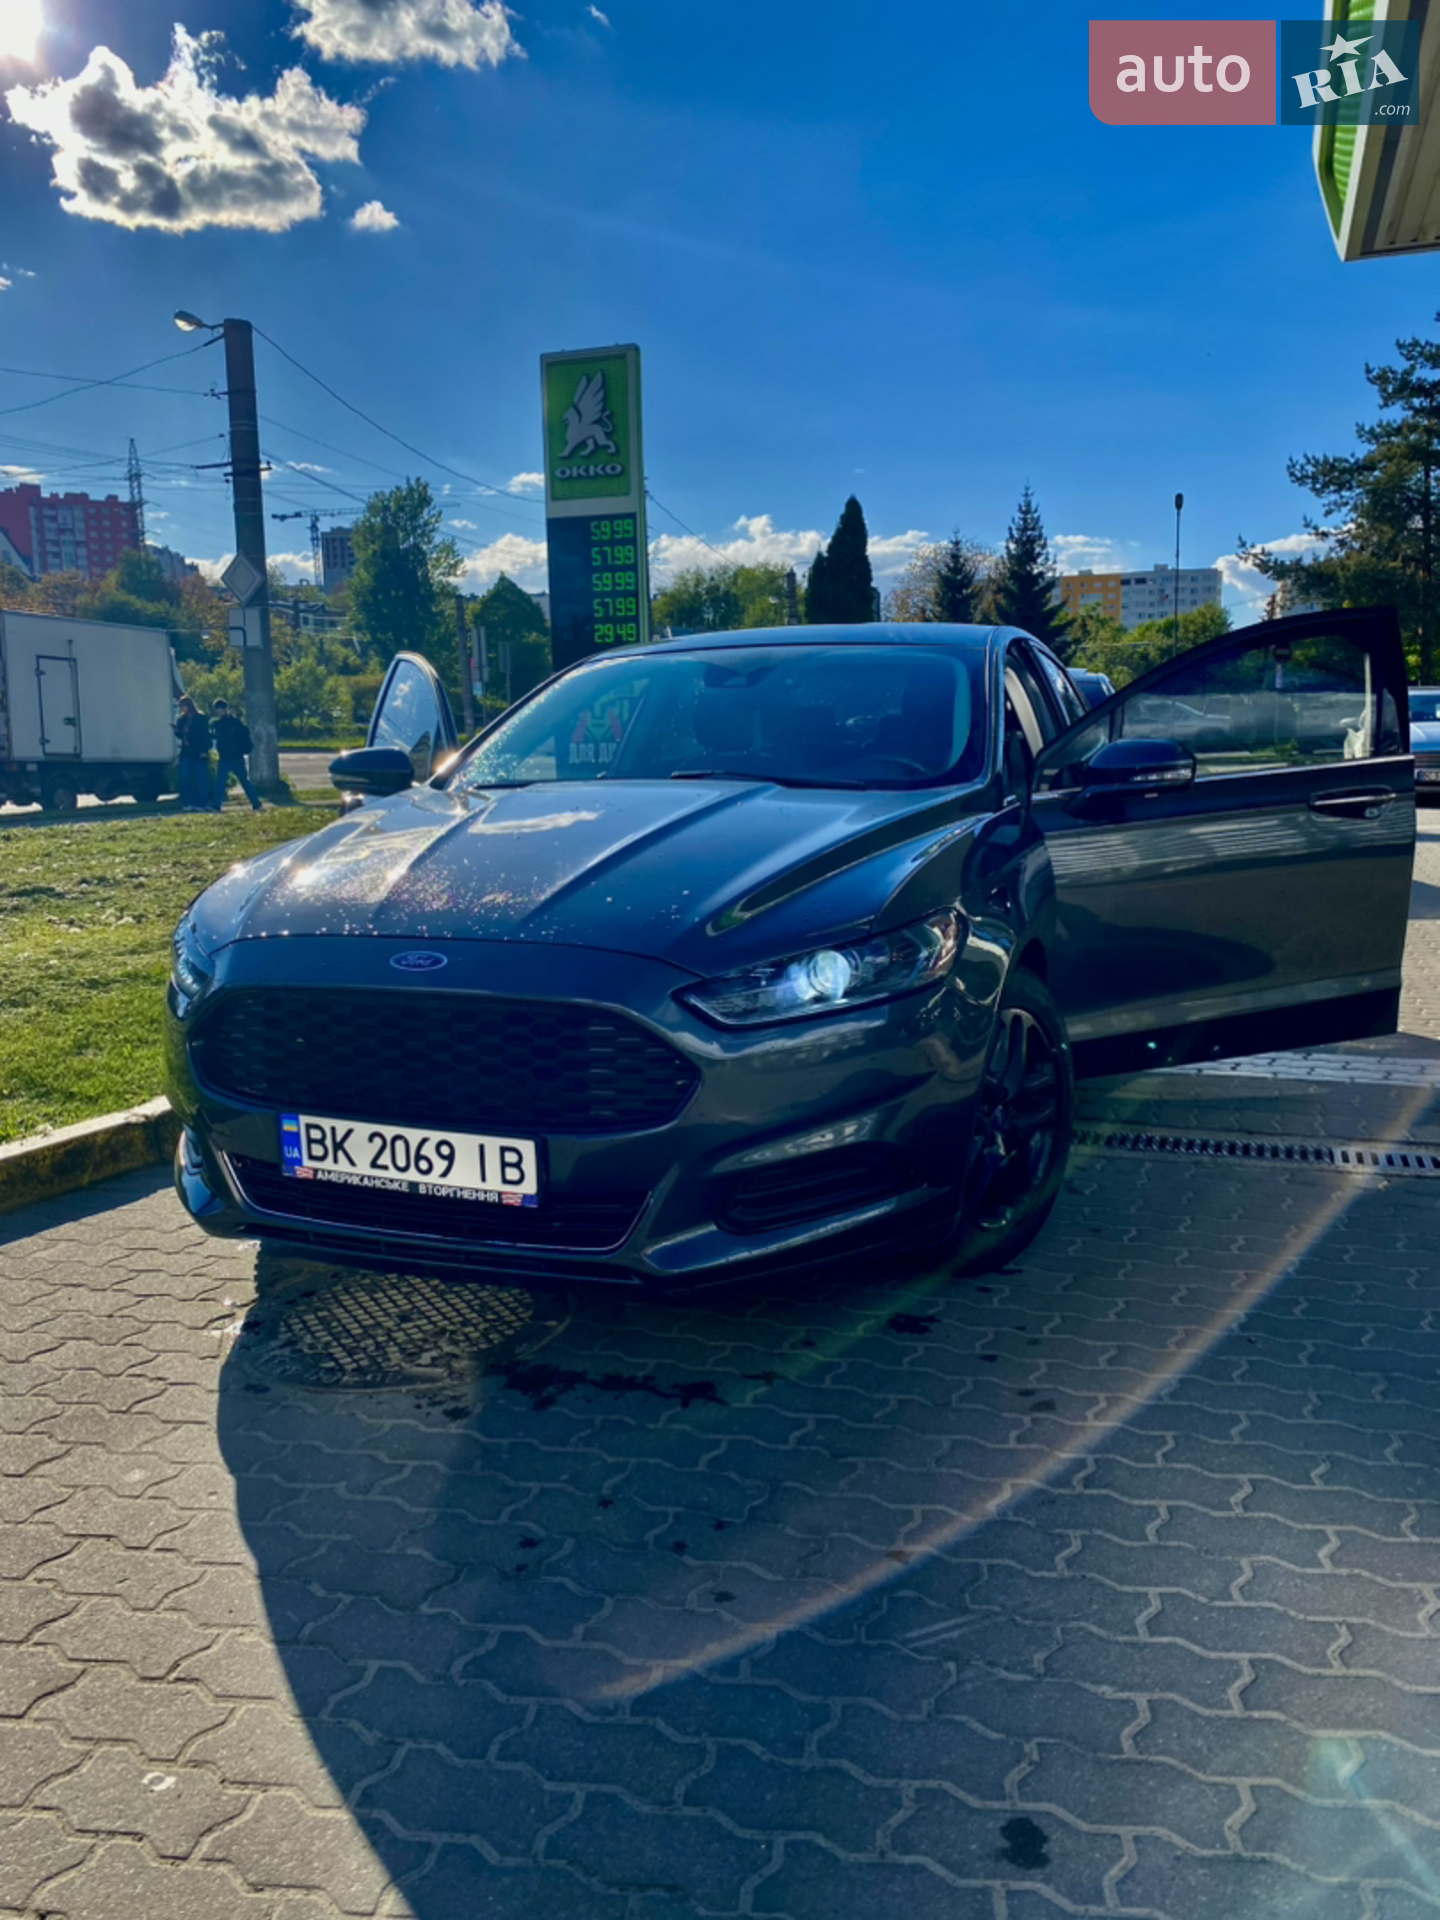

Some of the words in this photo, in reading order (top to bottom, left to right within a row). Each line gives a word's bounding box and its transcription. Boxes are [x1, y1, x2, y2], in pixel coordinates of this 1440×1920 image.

[555, 463, 623, 480] OKKO
[401, 954, 434, 967] Ford
[284, 1145, 300, 1159] UA
[304, 1122, 357, 1167] BK
[367, 1131, 456, 1178] 2069
[478, 1143, 526, 1186] IB
[316, 1170, 410, 1192] АМЕРИКАНСЬКЕ
[418, 1183, 499, 1203] ВТОРГНЕННЯ
